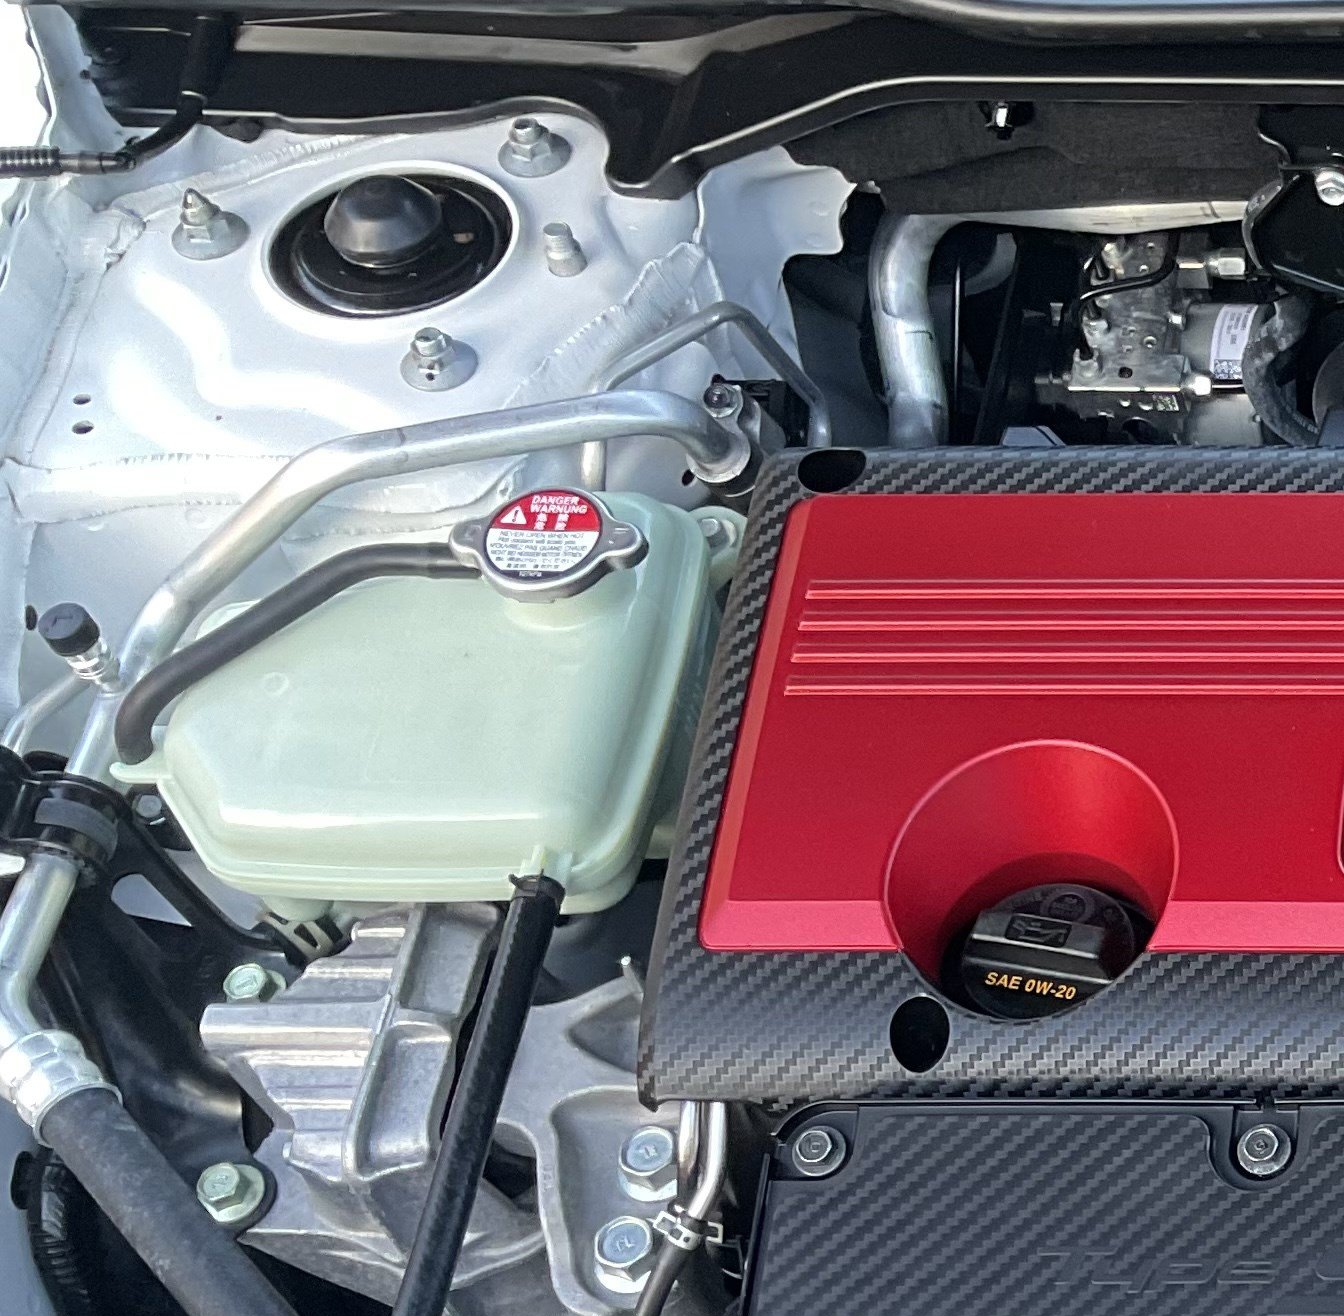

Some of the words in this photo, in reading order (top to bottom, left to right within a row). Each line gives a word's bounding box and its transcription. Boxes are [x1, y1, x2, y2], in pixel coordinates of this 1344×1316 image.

[532, 495, 580, 505] DANGER
[530, 504, 588, 514] WARNUNG
[984, 971, 1023, 990] SAE
[1024, 978, 1077, 1001] 0W-20
